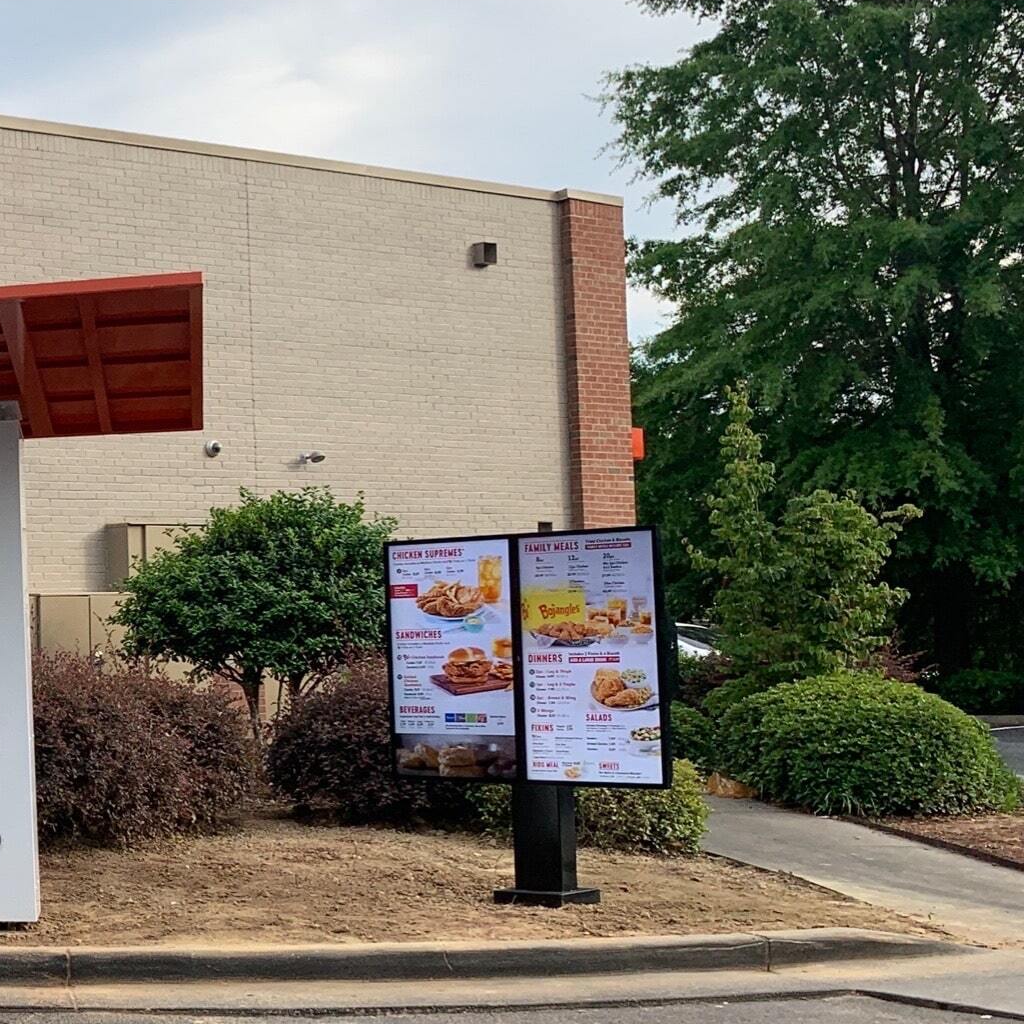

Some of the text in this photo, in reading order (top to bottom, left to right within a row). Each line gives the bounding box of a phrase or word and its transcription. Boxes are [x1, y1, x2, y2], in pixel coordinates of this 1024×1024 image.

[524, 541, 579, 553] FAMILY MEALS
[392, 550, 423, 561] CHICKEN
[396, 630, 442, 640] SANDWICHES
[528, 654, 563, 663] DINNERS
[399, 706, 435, 714] BEVERAGES
[586, 714, 613, 722] SALADS
[531, 724, 554, 732] FIXINS
